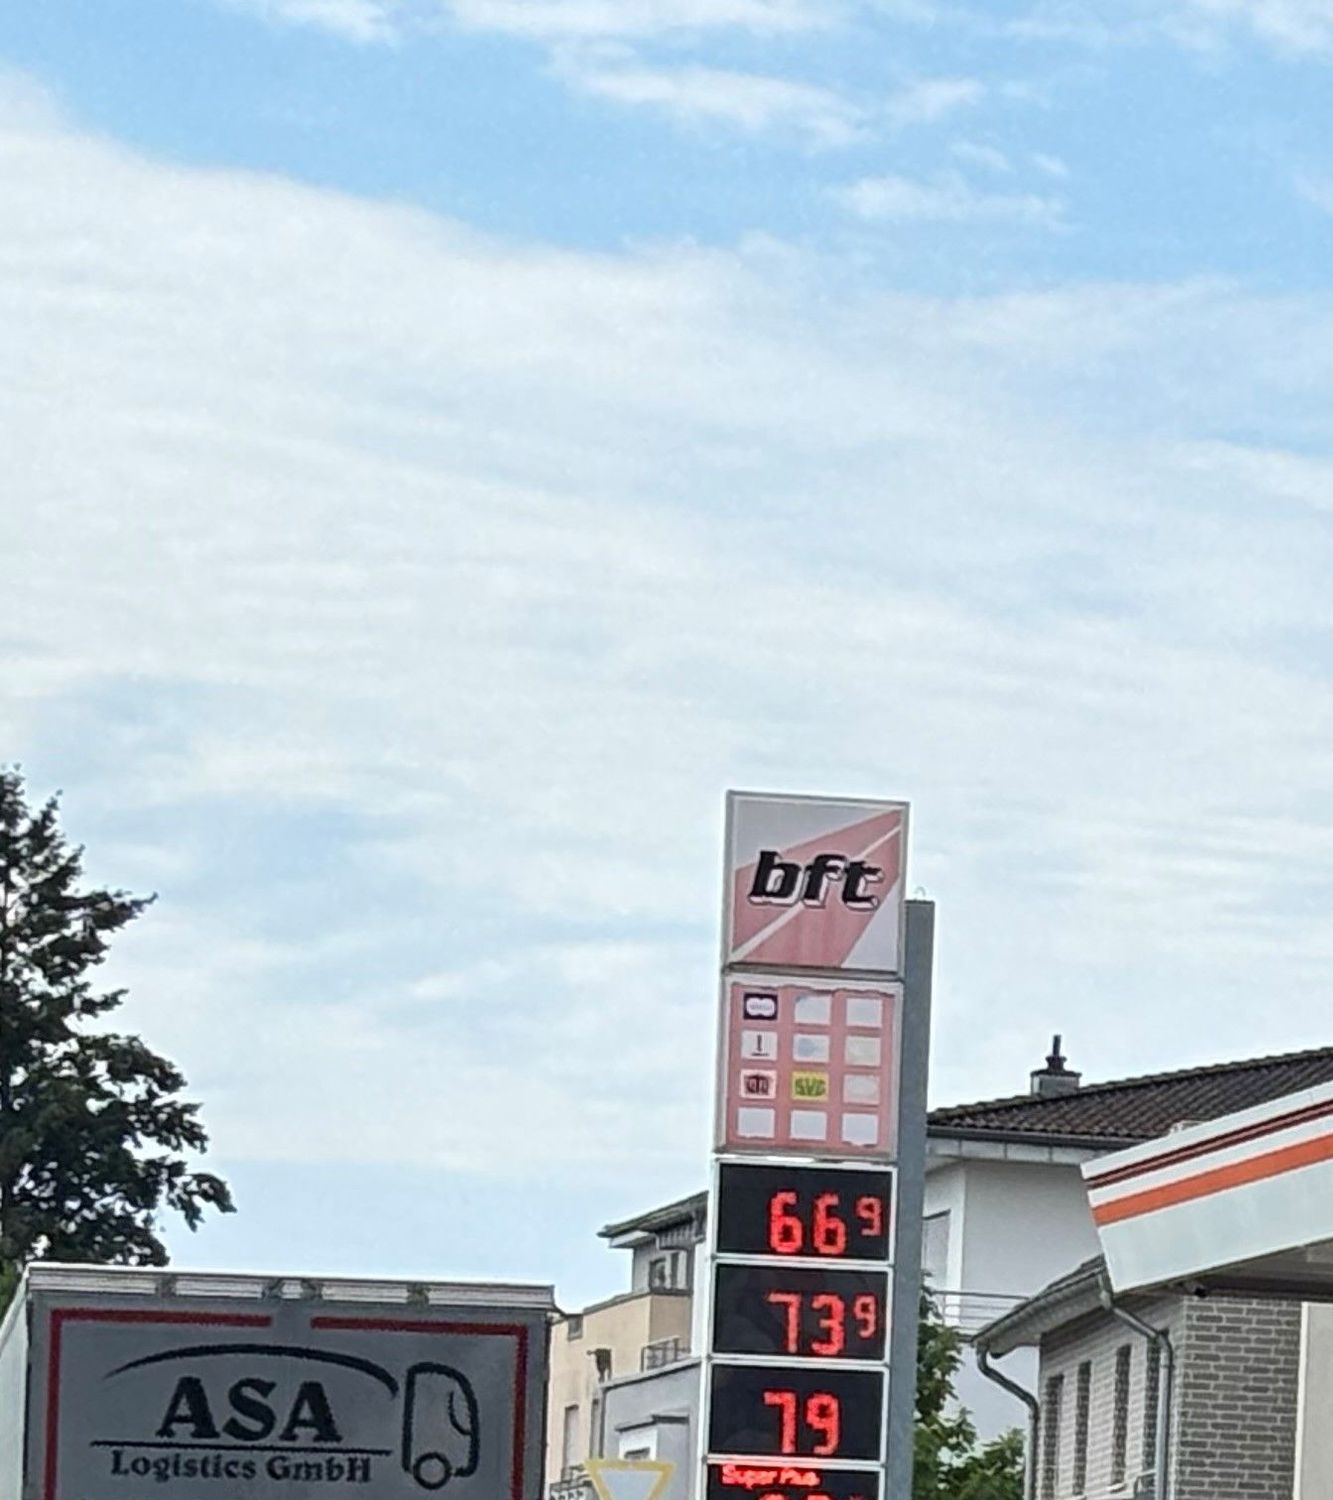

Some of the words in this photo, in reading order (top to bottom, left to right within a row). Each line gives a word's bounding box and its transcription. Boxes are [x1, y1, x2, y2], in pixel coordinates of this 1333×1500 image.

[747, 849, 885, 910] bft
[155, 1376, 343, 1442] ASA
[763, 1391, 842, 1457] 79
[110, 1450, 257, 1482] Logistics
[265, 1455, 371, 1483] GmbH
